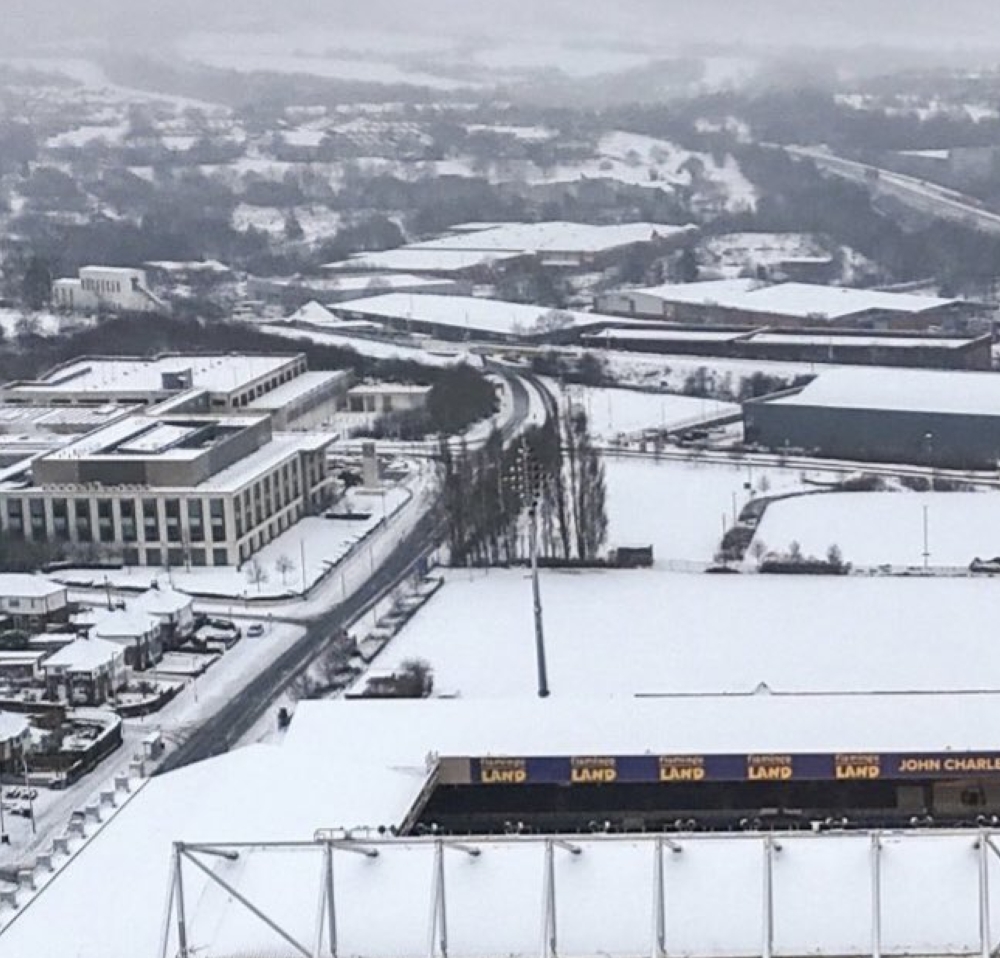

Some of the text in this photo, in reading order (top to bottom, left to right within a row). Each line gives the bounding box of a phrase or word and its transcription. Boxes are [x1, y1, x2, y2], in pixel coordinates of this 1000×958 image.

[835, 765, 880, 778] LAND
[898, 759, 940, 772] JOHN
[481, 768, 526, 782] LAND
[571, 768, 617, 782] LAND
[660, 767, 705, 780] LAND
[747, 766, 792, 779] LAND
